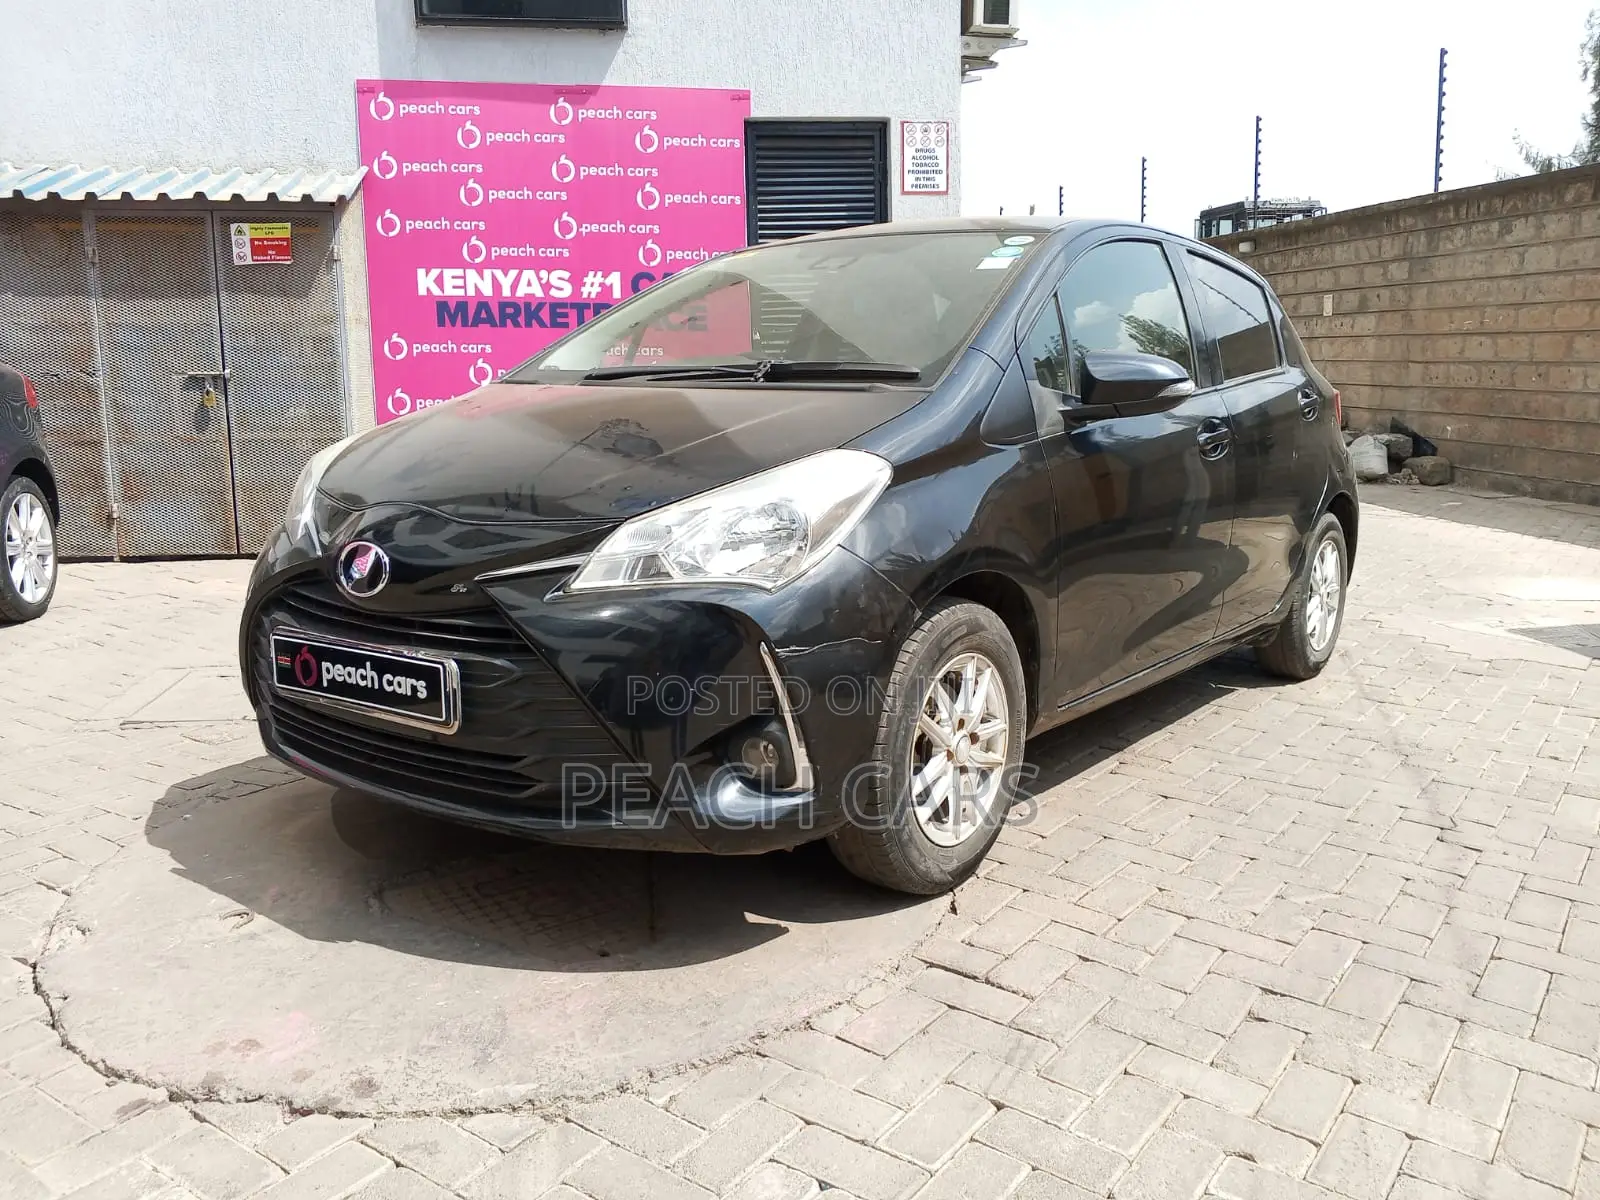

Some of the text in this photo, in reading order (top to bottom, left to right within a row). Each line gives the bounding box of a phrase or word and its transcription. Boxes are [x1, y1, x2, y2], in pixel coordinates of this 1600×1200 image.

[399, 100, 481, 118] peach cars
[577, 105, 658, 122] peach cars
[485, 128, 566, 146] peach cars
[663, 133, 741, 151] peach cars
[402, 159, 483, 176] peach cars
[579, 162, 659, 180] peach cars
[488, 186, 568, 203] peach cars
[663, 190, 741, 208] peach cars
[405, 216, 486, 234] peach cars
[582, 219, 660, 237] peach cars
[491, 242, 570, 260] peach cars
[666, 247, 709, 264] peach
[417, 267, 573, 298] KENYA'S
[580, 268, 622, 299] #1
[412, 340, 493, 357] peach cars
[321, 661, 428, 700] peach cars
